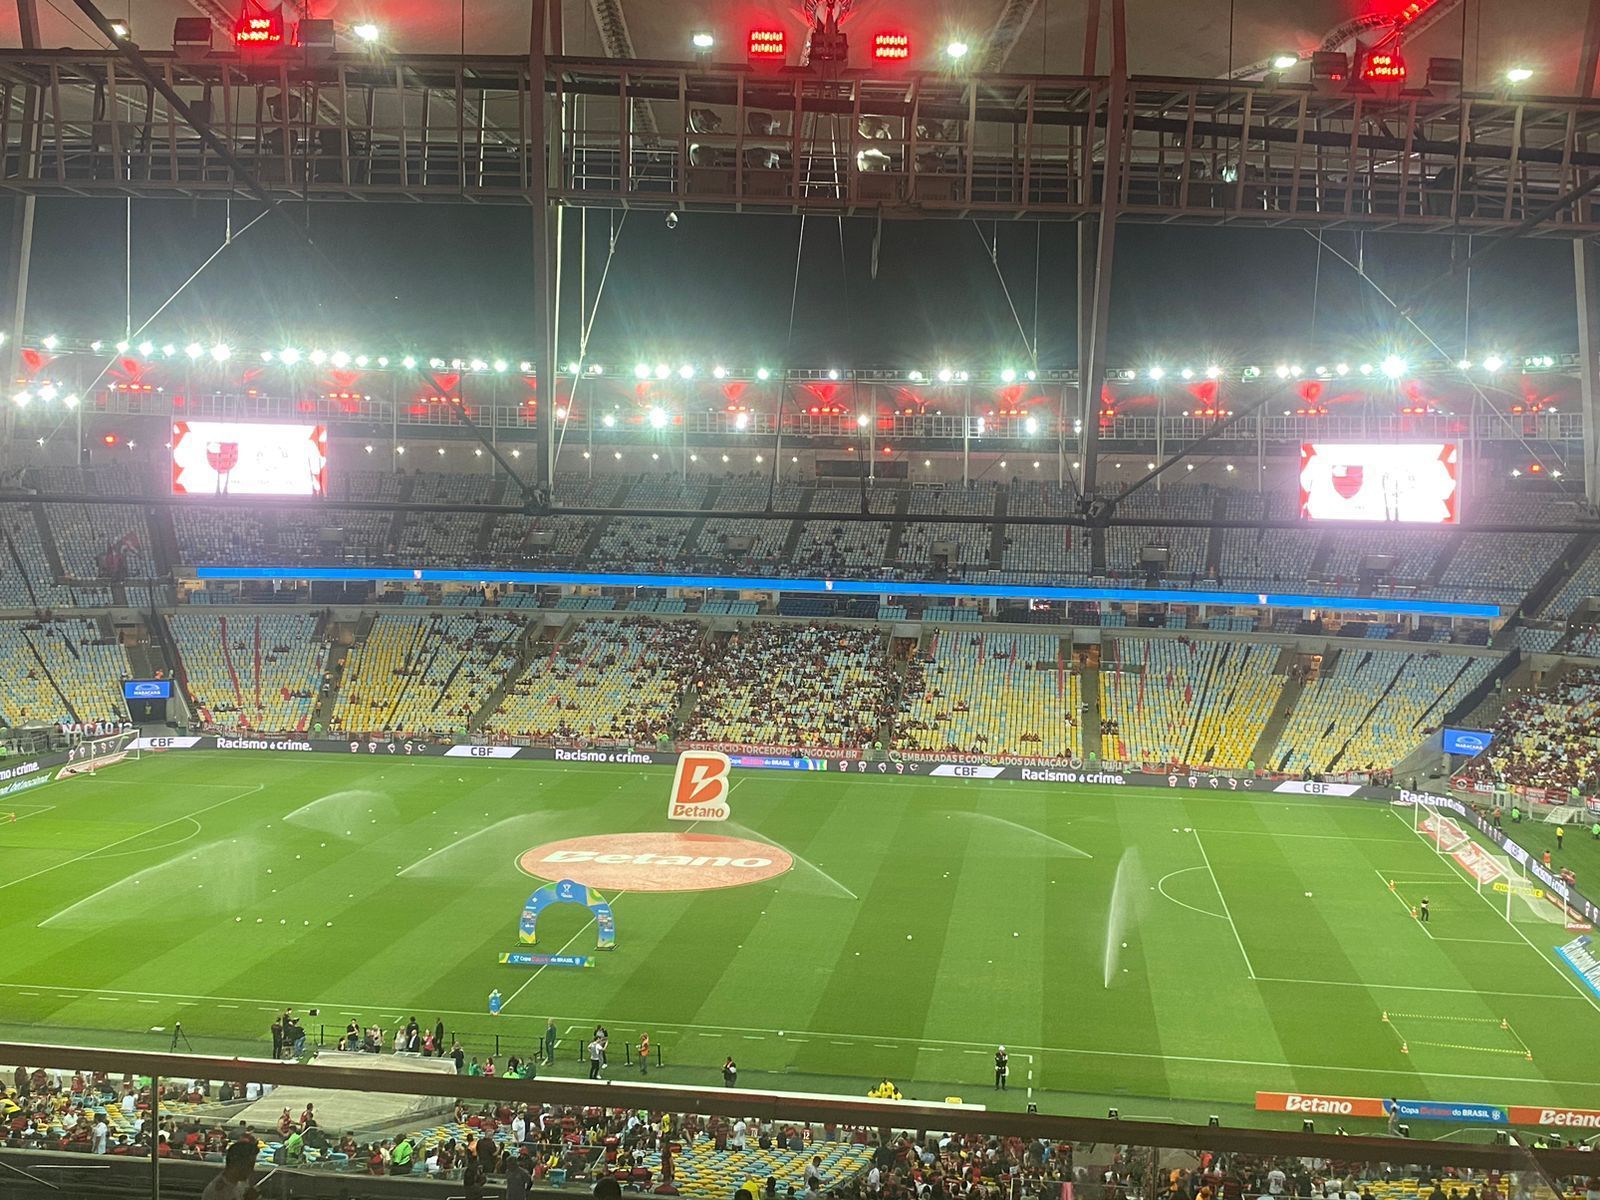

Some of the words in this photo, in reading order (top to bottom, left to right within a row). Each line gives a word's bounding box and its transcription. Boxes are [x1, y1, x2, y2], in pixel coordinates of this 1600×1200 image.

[150, 738, 174, 747] CBF
[216, 737, 268, 750] Racismo
[276, 740, 313, 751] crime.
[470, 746, 494, 756] CBF
[555, 749, 606, 762] Racismo
[616, 751, 653, 764] crime.
[902, 752, 957, 763] EMBAIXADAS
[959, 755, 964, 763] E
[1024, 757, 1037, 767] DA
[1038, 757, 1068, 769] NAÇÃO
[954, 766, 979, 776] CBF
[1021, 768, 1077, 783] Racismo
[1086, 772, 1126, 785] crime.
[1303, 783, 1329, 794] CBF
[673, 804, 725, 818] Betano
[540, 850, 772, 868] Betano
[1285, 1095, 1352, 1114] Betano
[1400, 1106, 1419, 1115] Copa
[1452, 1108, 1462, 1116] do
[1462, 1109, 1490, 1118] BRASIL
